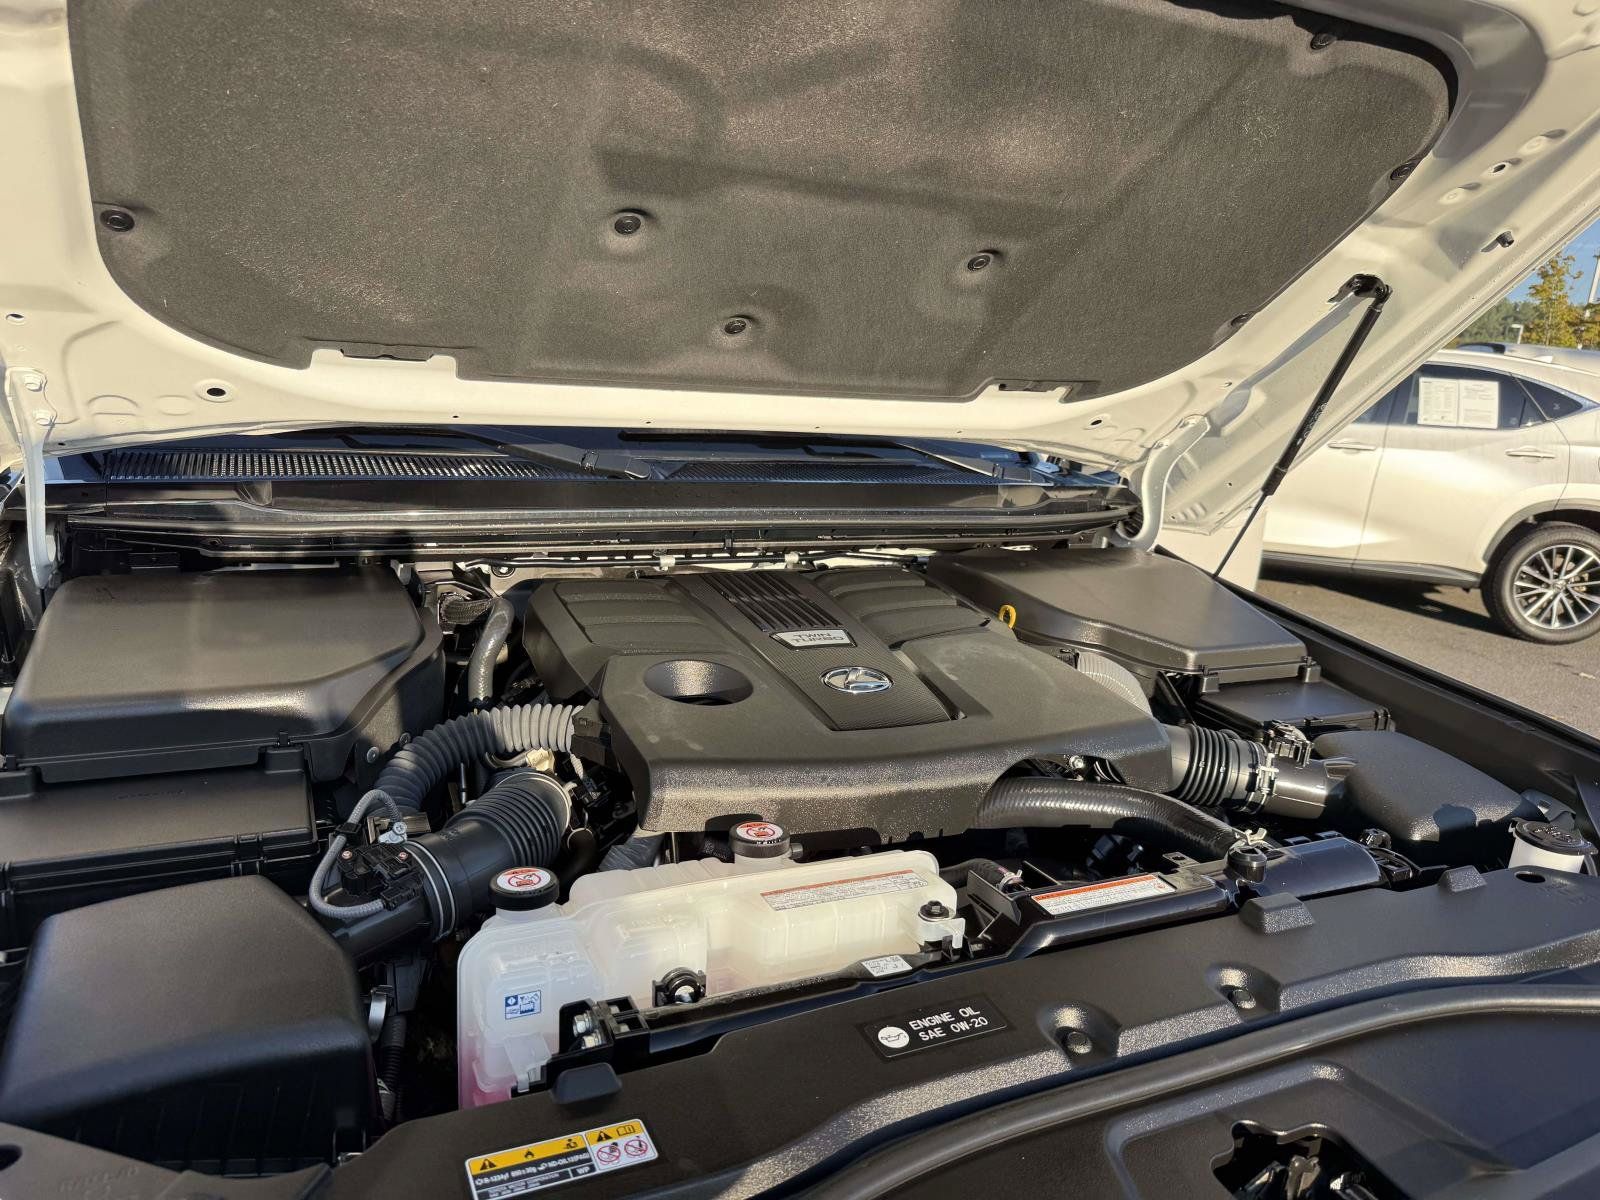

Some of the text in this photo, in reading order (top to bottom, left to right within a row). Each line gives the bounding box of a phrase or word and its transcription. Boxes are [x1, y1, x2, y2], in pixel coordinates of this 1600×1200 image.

[909, 1006, 980, 1030] ENGINE OIL
[918, 1016, 988, 1041] SAE 0W-20
[576, 1166, 590, 1175] WP
